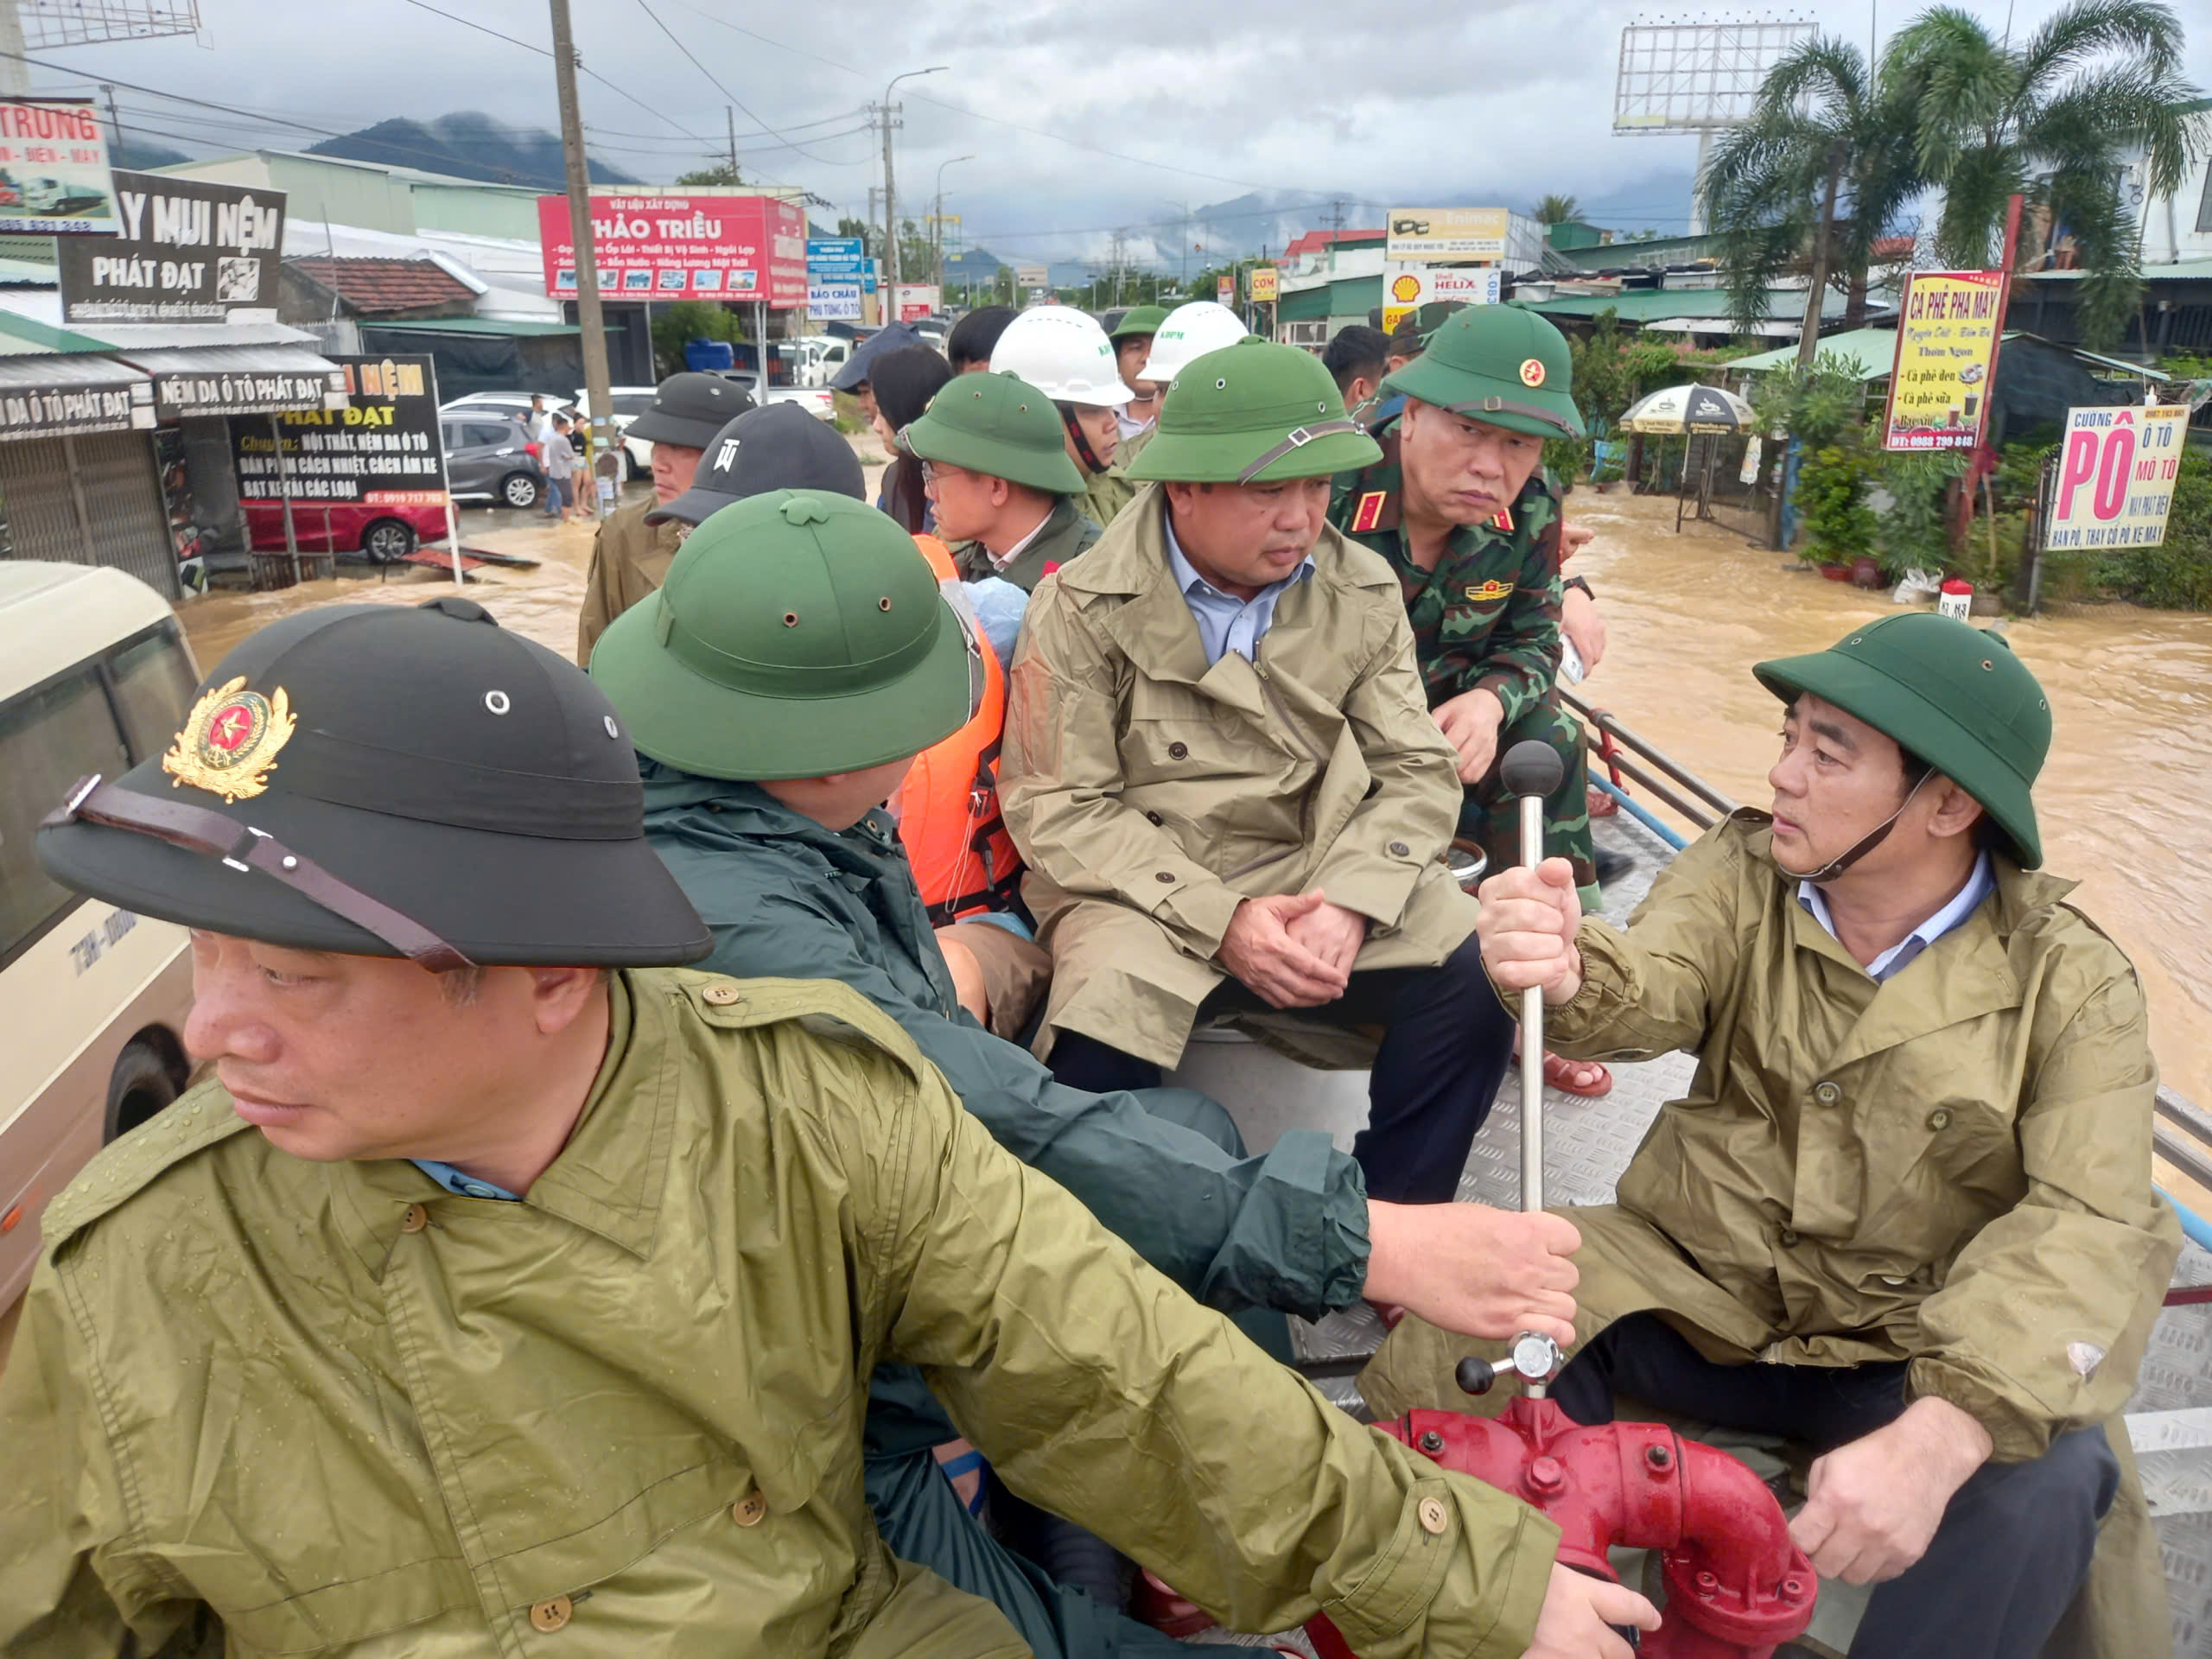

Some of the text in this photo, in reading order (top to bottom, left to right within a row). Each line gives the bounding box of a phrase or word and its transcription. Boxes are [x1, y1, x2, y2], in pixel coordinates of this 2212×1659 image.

[0, 105, 97, 140] TRUNG
[217, 194, 278, 257] NỆM
[589, 212, 651, 239] HẢO
[92, 252, 206, 296] PHÁT ĐẠT
[1434, 278, 1478, 290] HELIX
[1910, 283, 1925, 320] CÀ
[1926, 283, 1949, 320] PHÊ
[1948, 290, 1970, 320] PHA
[197, 379, 219, 404] DA
[221, 373, 233, 403] Ô
[234, 373, 256, 403] TÔ
[255, 374, 294, 401] PHÁT
[296, 378, 323, 403] ĐẠT
[359, 358, 425, 402] NỆM
[62, 387, 101, 421] PHÁT
[102, 391, 130, 420] ĐẠT
[342, 405, 396, 429] ĐẠT
[2142, 422, 2173, 448] Ô TÔ
[2056, 410, 2136, 521] PÔ
[2134, 455, 2177, 481] MÔ TÔ
